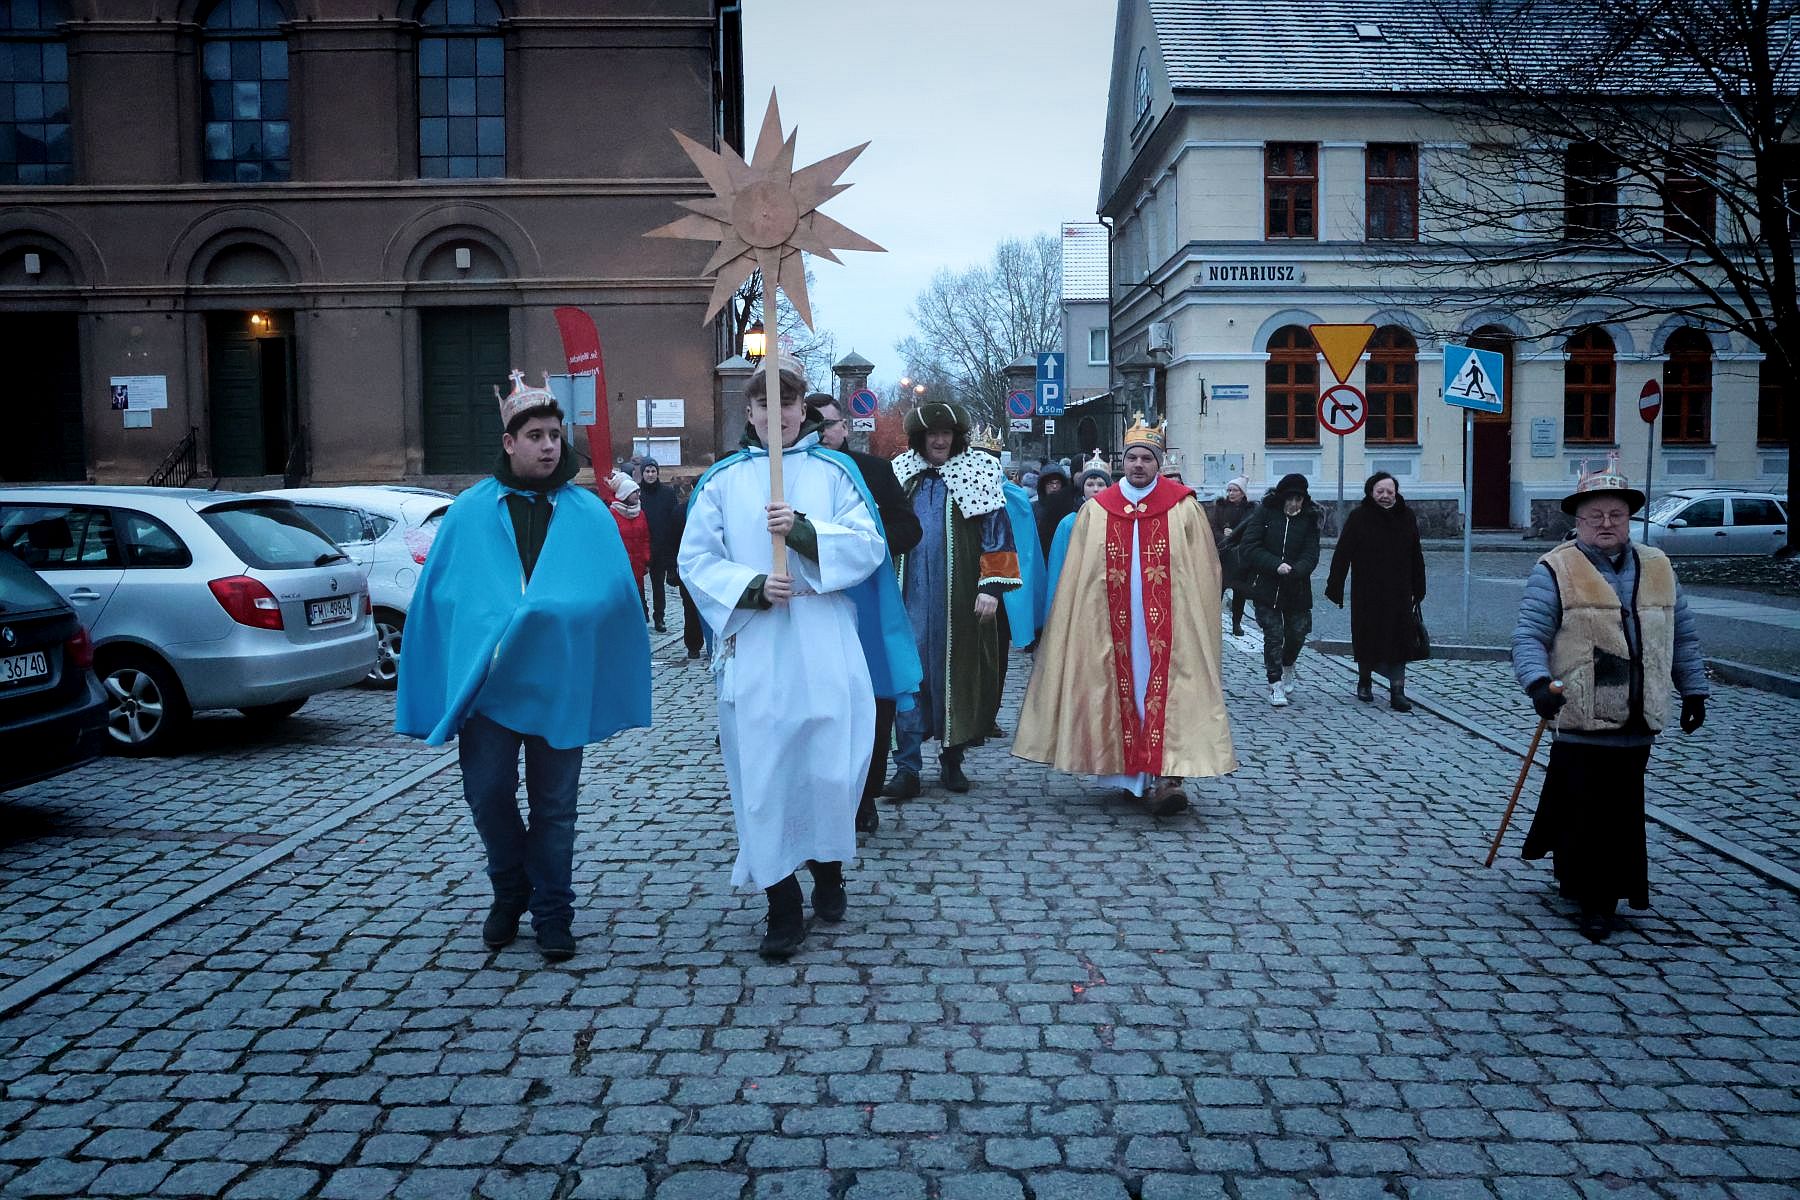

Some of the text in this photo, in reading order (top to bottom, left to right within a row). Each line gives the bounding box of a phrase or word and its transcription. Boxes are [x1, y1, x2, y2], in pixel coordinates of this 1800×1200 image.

[1209, 266, 1294, 281] NOTARIUSZ
[1043, 384, 1059, 405] P
[4, 654, 46, 679] 36740
